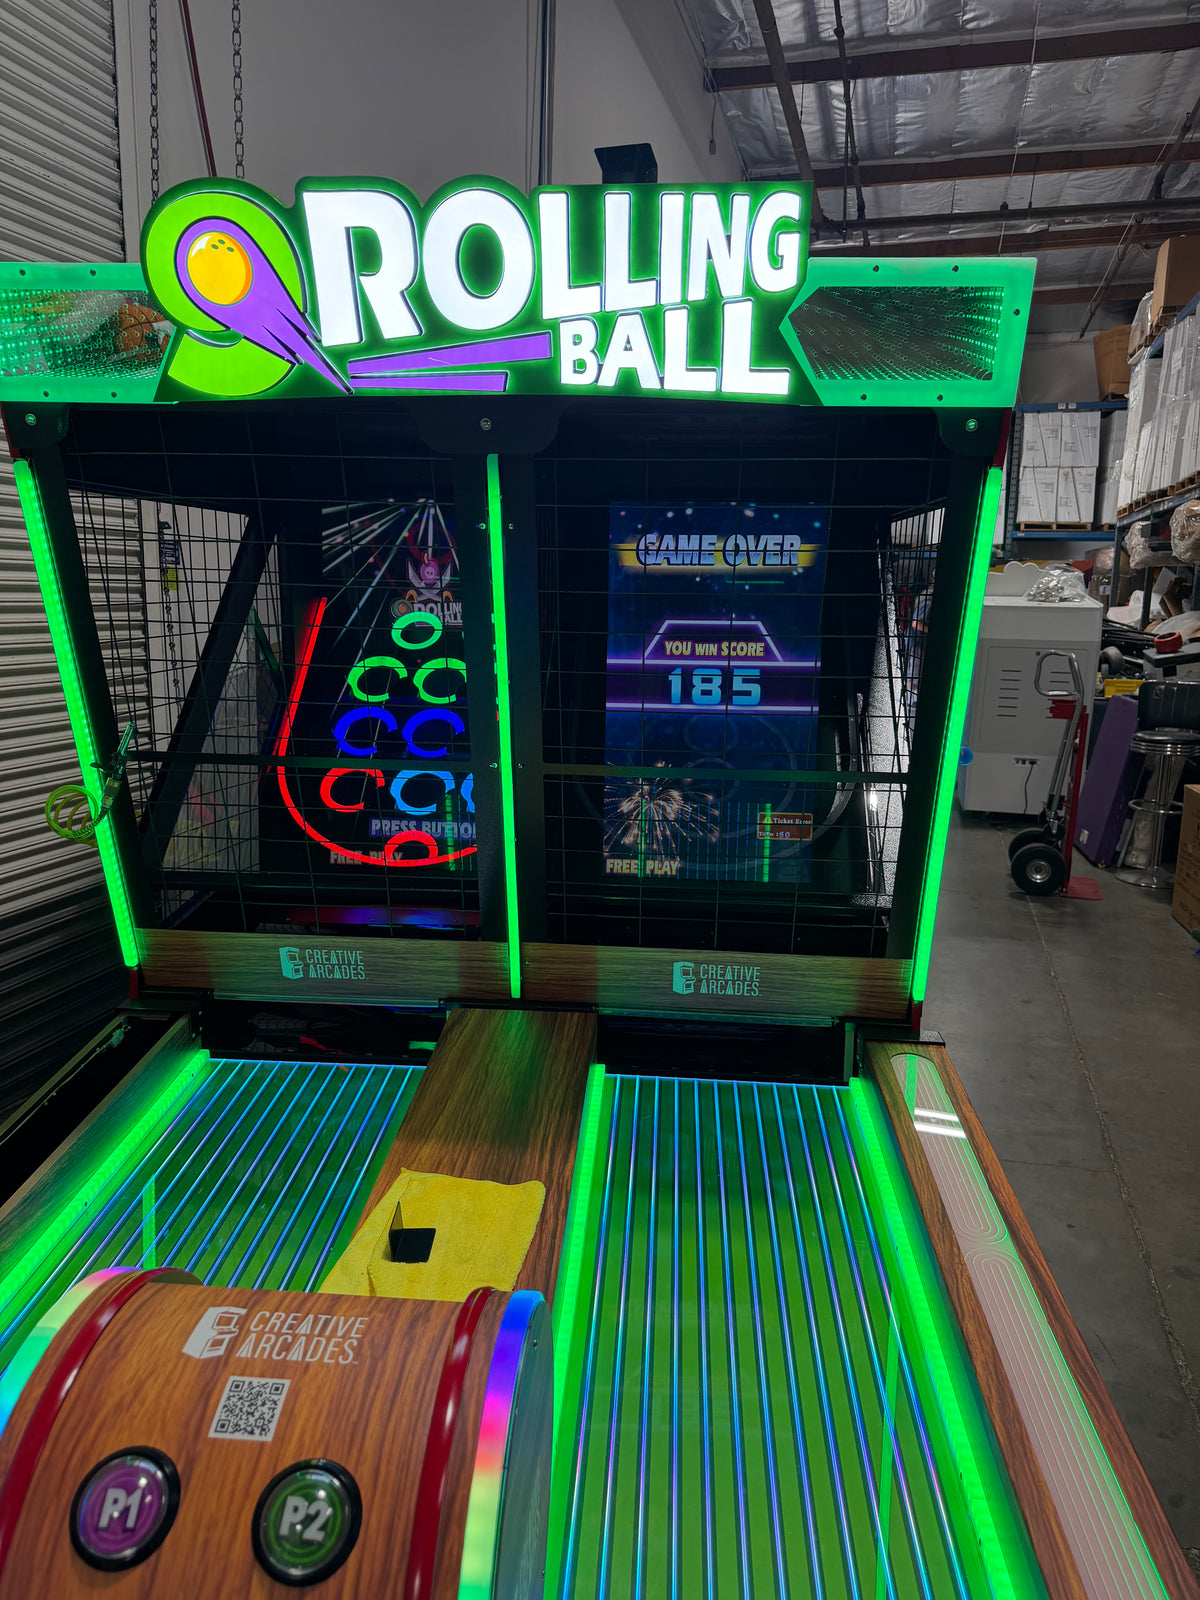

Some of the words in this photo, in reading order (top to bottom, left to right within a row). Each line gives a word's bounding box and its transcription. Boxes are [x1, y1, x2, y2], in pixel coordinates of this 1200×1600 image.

[303, 188, 801, 347] ROLLING
[560, 299, 791, 395] BALL
[637, 534, 717, 567] GAME
[722, 534, 801, 567] OVER
[664, 641, 692, 656] YOU
[695, 643, 718, 656] WIN
[721, 641, 765, 657] SCORE
[668, 667, 761, 706] 185
[371, 819, 418, 836] PRESS
[421, 821, 477, 839] BUTTO
[606, 859, 639, 874] FREE
[645, 860, 679, 876] PLAY
[305, 949, 365, 966] CREATIVE
[308, 964, 366, 980] ARCADES
[700, 964, 761, 982] CREATIVE
[699, 979, 760, 997] ARCADES
[249, 1310, 369, 1338] CREATIVE
[235, 1334, 357, 1365] ARCADES
[97, 1487, 144, 1531] P1
[278, 1495, 334, 1542] P2
